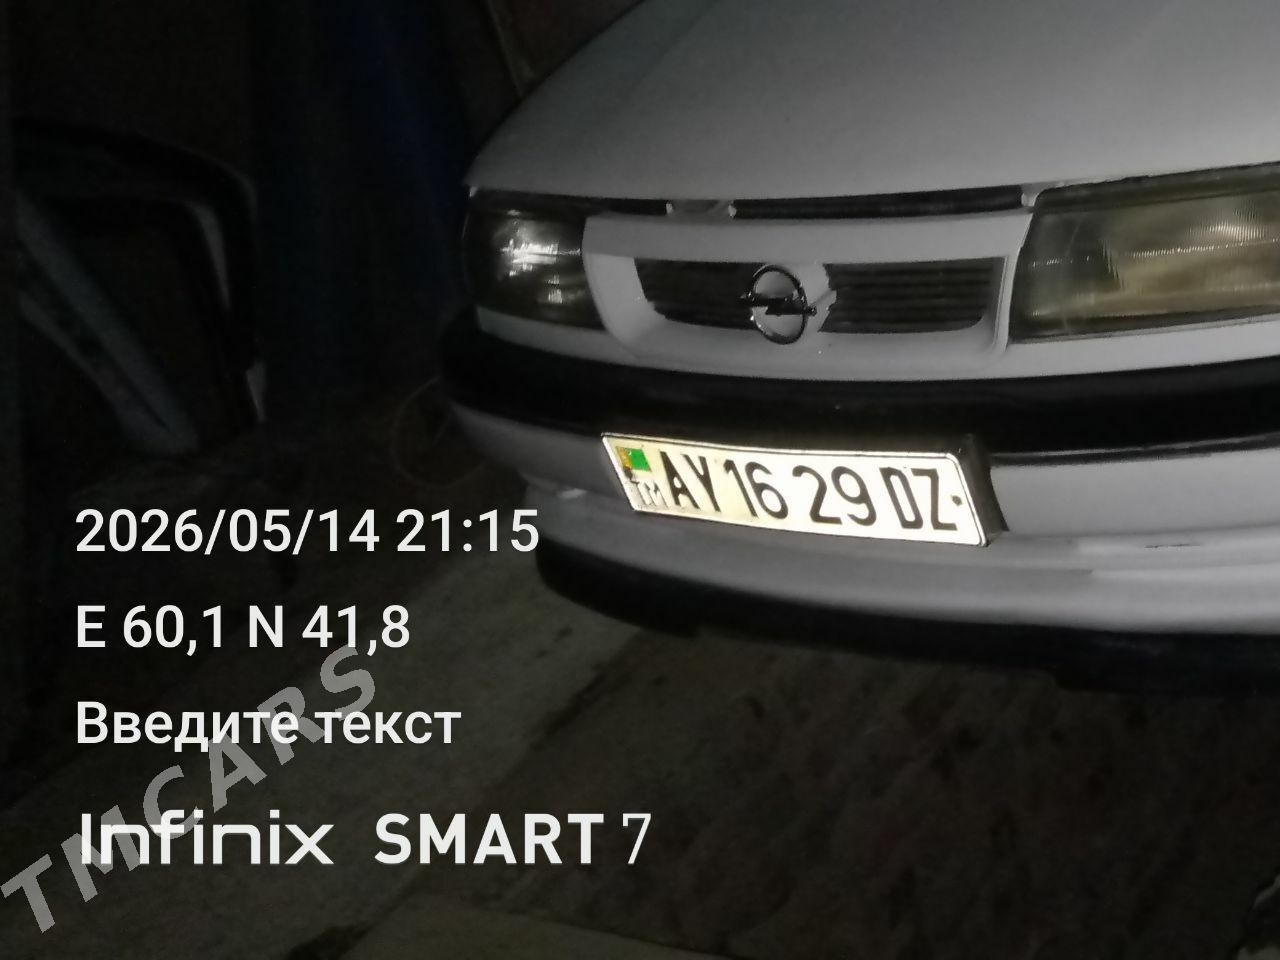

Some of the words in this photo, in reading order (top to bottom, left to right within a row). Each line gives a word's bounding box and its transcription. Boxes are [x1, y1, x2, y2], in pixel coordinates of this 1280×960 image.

[659, 450, 721, 512] AY
[723, 459, 788, 520] 16
[792, 464, 877, 526] 29
[878, 466, 958, 531] DZ
